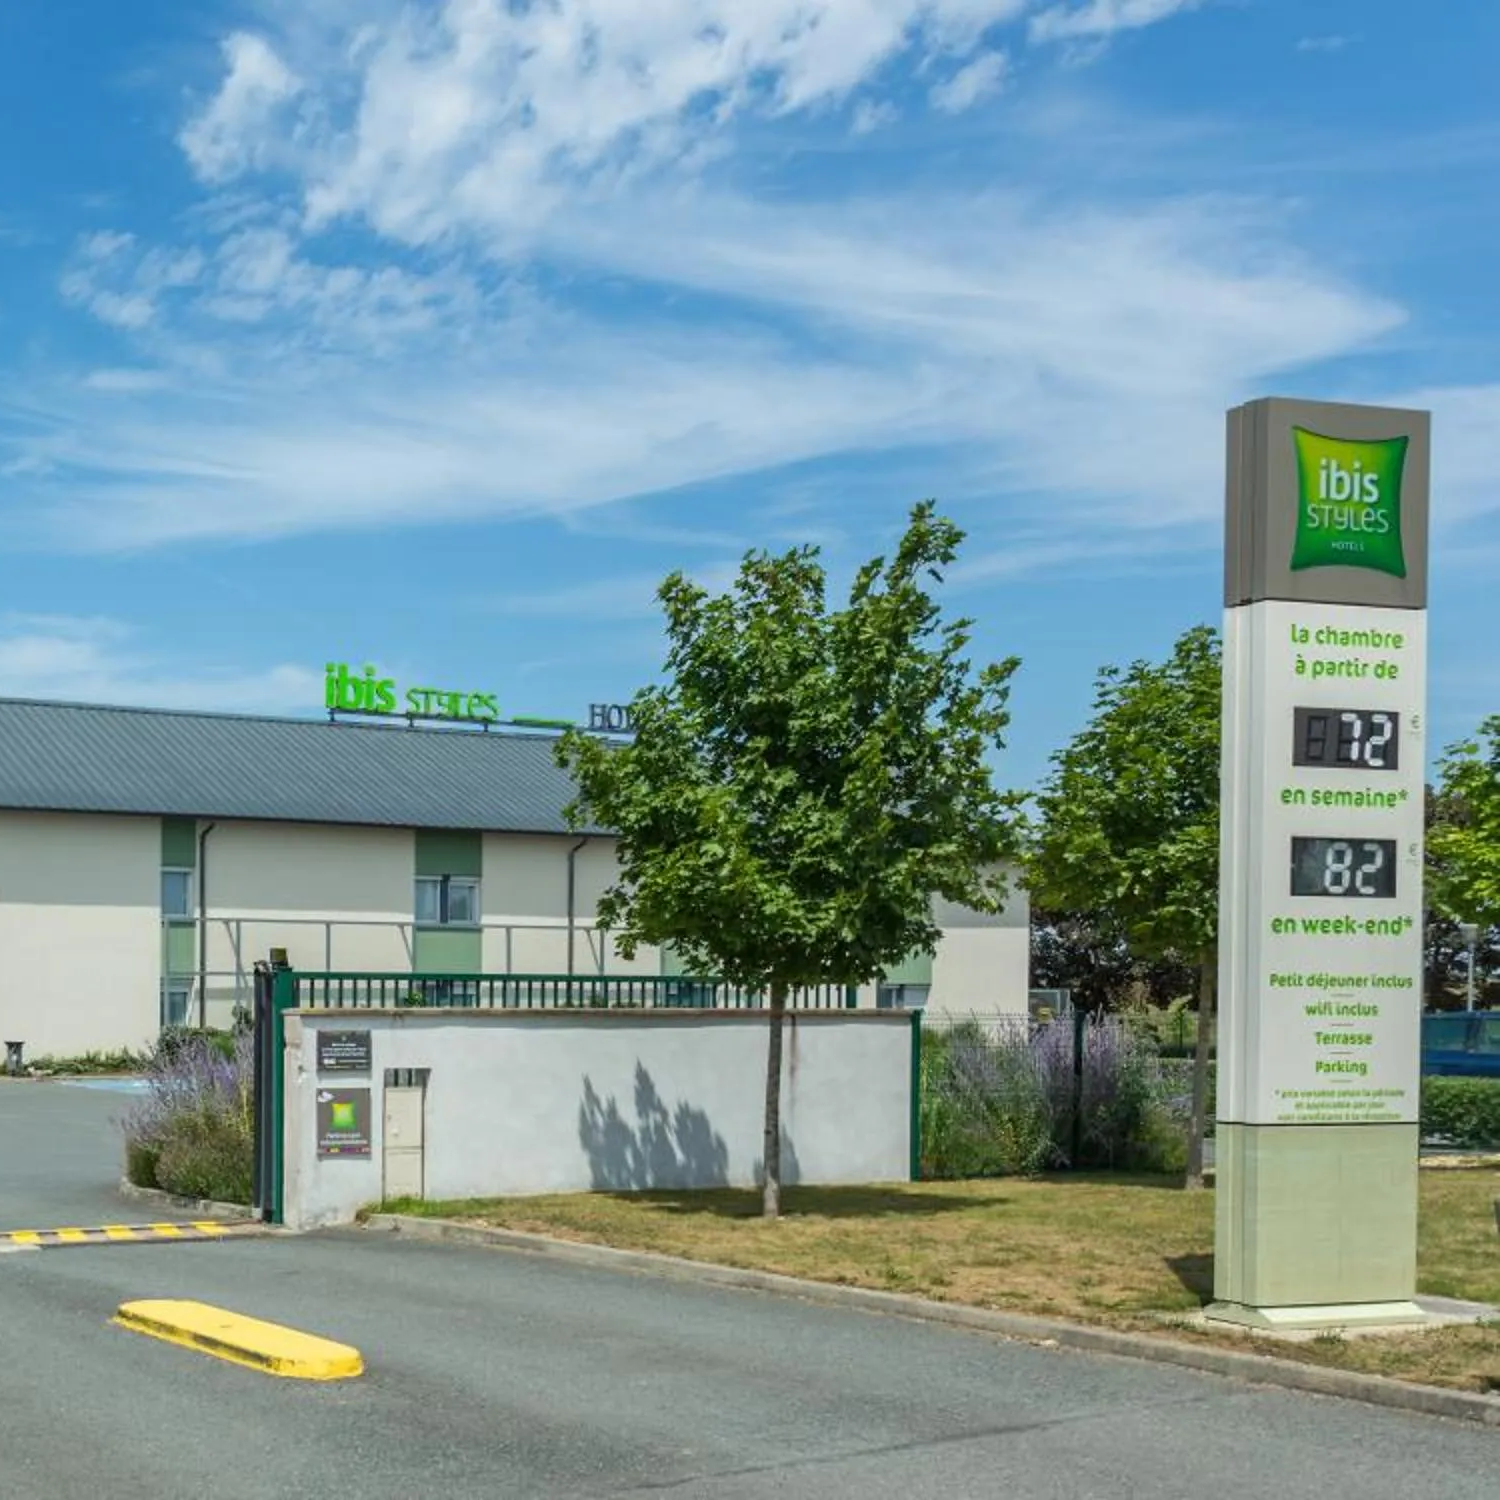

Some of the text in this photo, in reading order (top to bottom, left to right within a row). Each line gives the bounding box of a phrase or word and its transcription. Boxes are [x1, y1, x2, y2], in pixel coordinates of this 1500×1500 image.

[1319, 458, 1380, 503] ibis
[1291, 624, 1404, 649] la chambre
[1295, 654, 1399, 680] à partir de
[325, 662, 396, 713] ibis
[1341, 712, 1393, 767] 72
[1280, 788, 1305, 805] en
[1324, 842, 1383, 895] 82
[1271, 916, 1297, 934] en
[1269, 973, 1413, 991] Petit déjeuner inclus
[1305, 1001, 1378, 1017] wifi inclus
[1315, 1031, 1373, 1045] Terrasse
[1315, 1061, 1368, 1076] Parking
